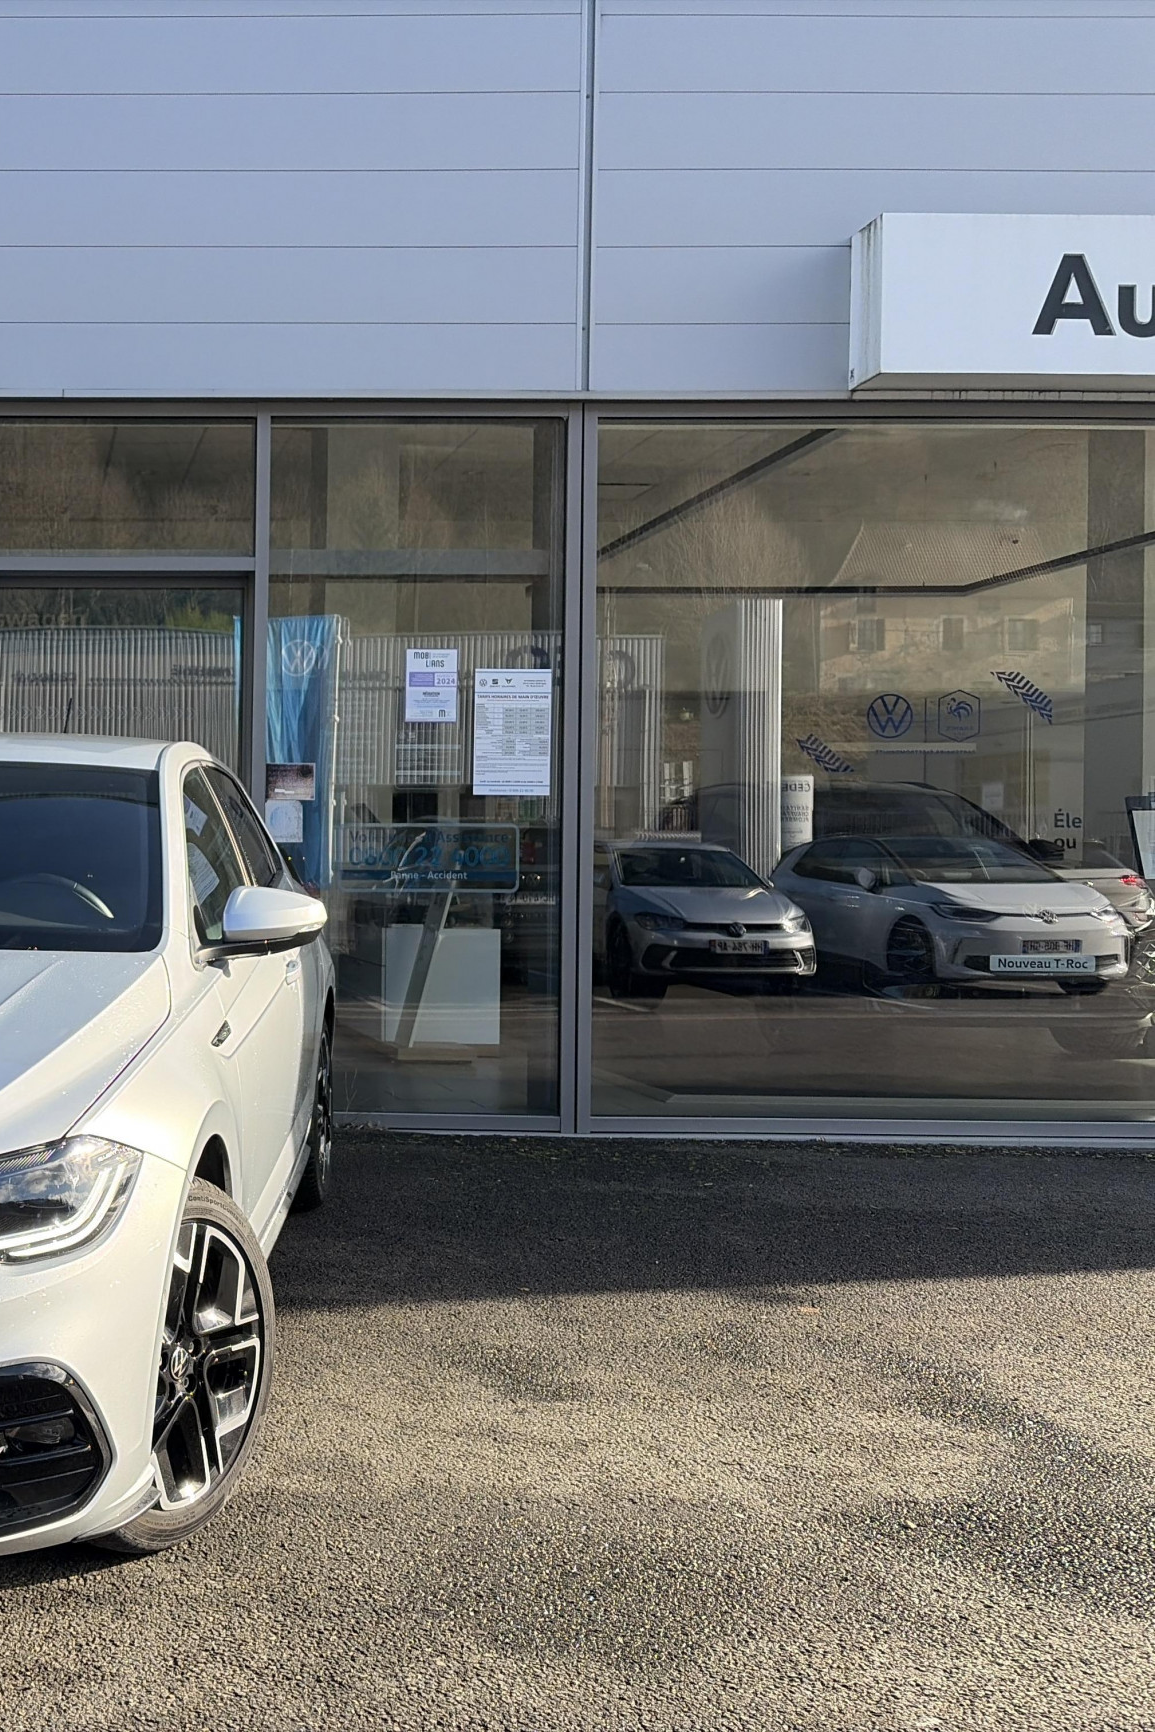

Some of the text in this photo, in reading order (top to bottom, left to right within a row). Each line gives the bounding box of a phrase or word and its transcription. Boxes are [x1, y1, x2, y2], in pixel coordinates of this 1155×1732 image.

[1032, 253, 1155, 338] Au
[1053, 808, 1082, 829] Éle
[390, 870, 419, 880] Panne
[427, 870, 468, 880] Accident
[997, 958, 1089, 969] Nouveau T-Roc
